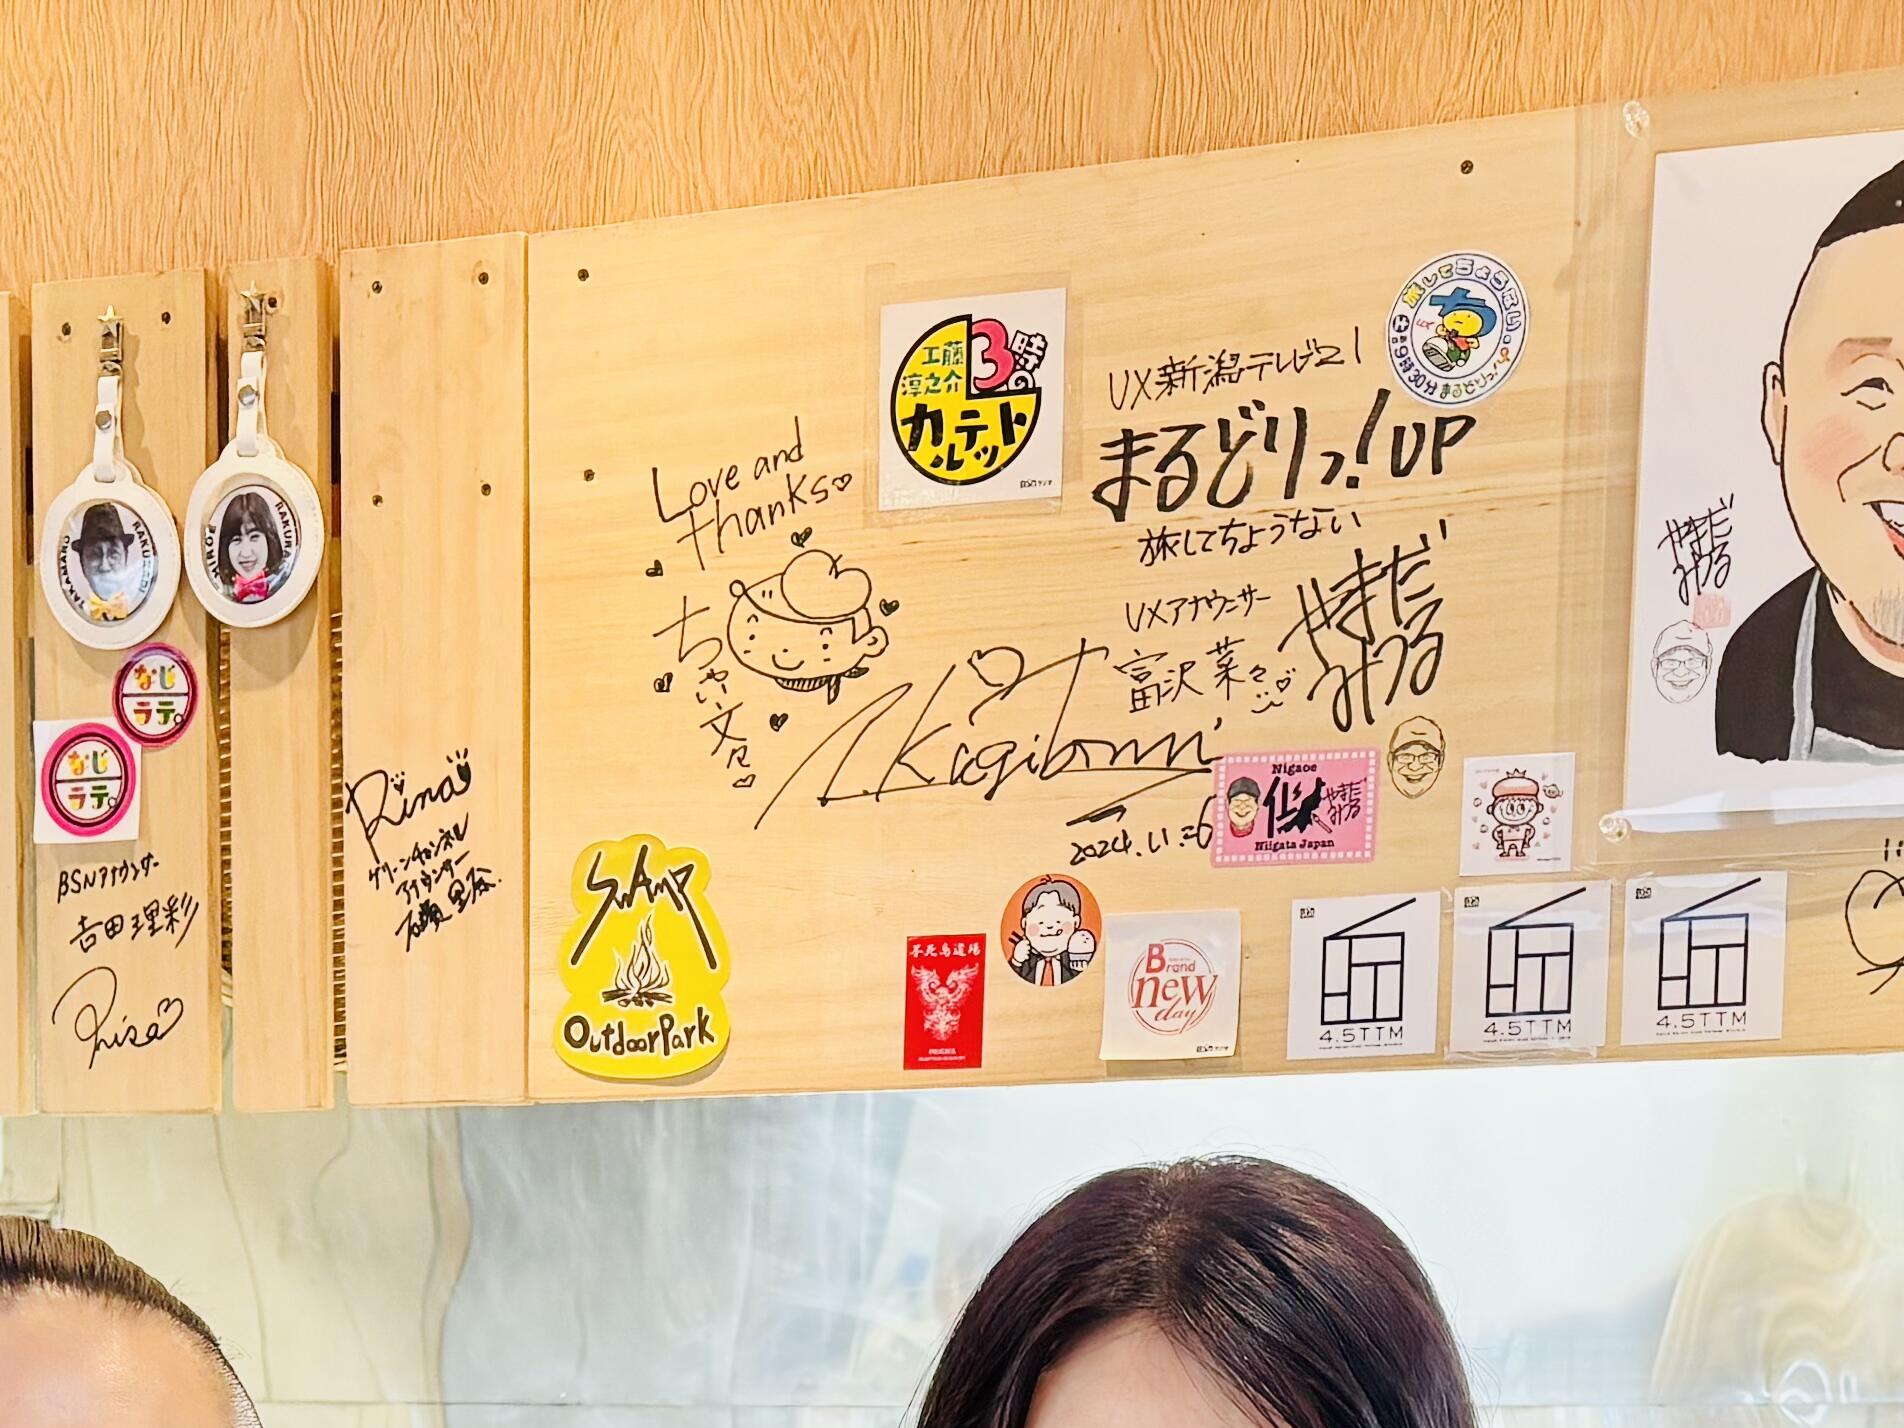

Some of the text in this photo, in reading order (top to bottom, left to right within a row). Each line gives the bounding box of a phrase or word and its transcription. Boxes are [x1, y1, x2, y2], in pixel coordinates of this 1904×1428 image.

[973, 319, 1015, 389] 3
[651, 415, 805, 525] Love and
[1137, 510, 1362, 566] 旅してちょうない
[1125, 585, 1271, 631] UXアナウンサー
[134, 664, 176, 690] なじ
[67, 748, 108, 776] なじ
[1271, 762, 1318, 776] Nigaoe
[1299, 837, 1335, 850] Japan
[1146, 943, 1196, 974] Brand
[1131, 974, 1218, 1010] new
[563, 1007, 715, 1057] OutdoorPark
[1319, 1025, 1404, 1044] 4.5TTM
[1483, 1018, 1572, 1037] 4.5TTM
[1656, 1011, 1747, 1030] 4.5TTM
